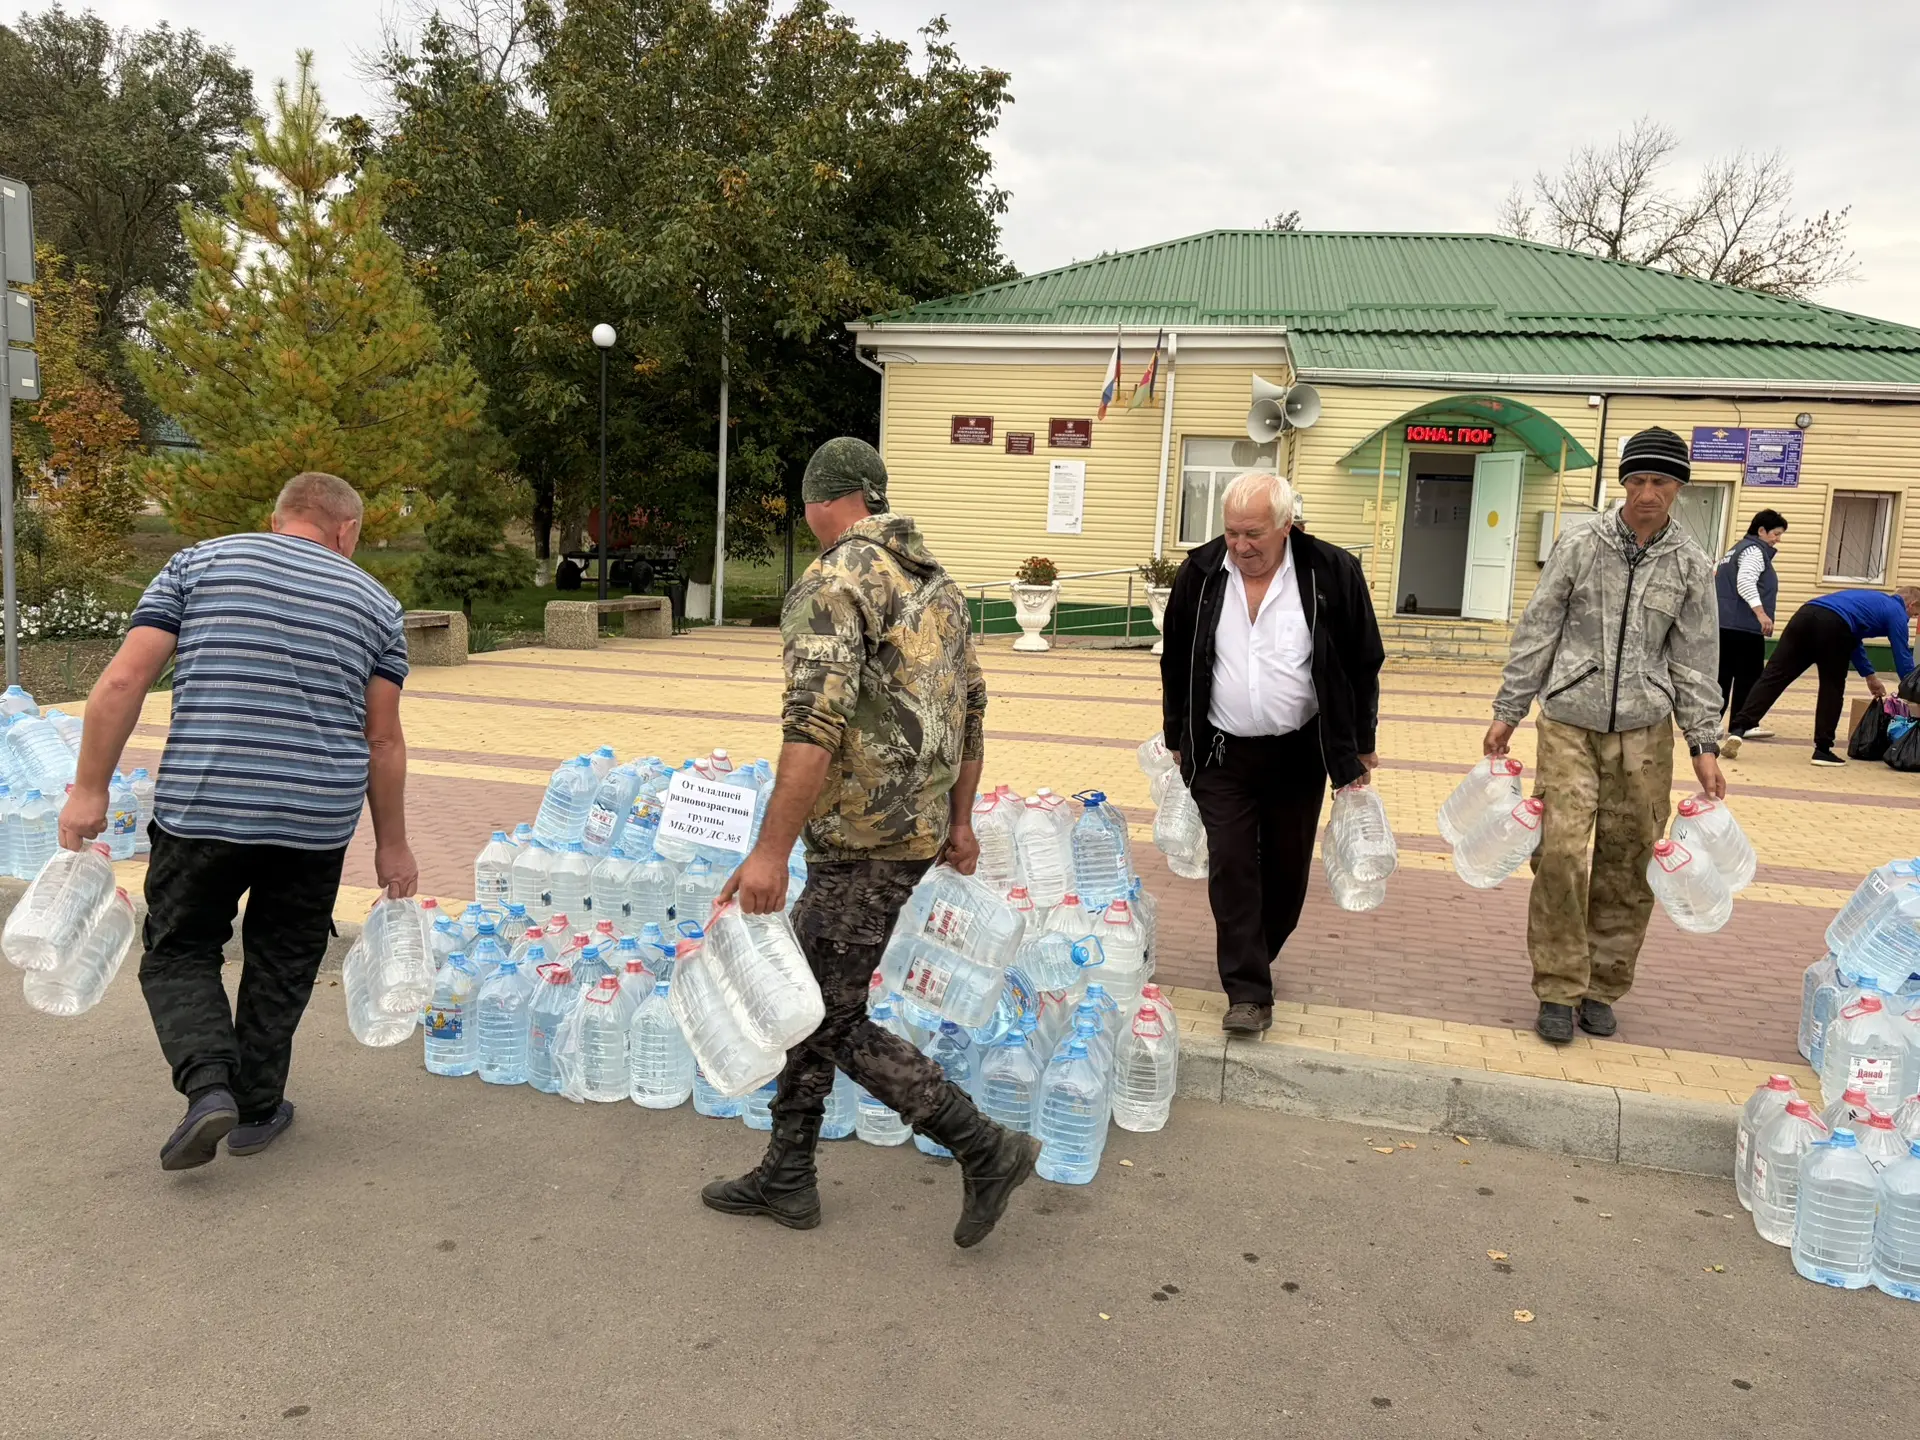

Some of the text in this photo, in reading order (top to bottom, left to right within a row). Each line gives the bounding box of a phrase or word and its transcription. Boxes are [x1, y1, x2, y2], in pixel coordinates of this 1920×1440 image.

[682, 780, 741, 800] От младшей
[670, 793, 749, 817] разновозрастной
[687, 812, 724, 826] группы
[668, 819, 708, 836] МБДОУ
[706, 830, 725, 840] ДС
[916, 968, 932, 995] Данай
[1856, 1068, 1883, 1080] Данай
